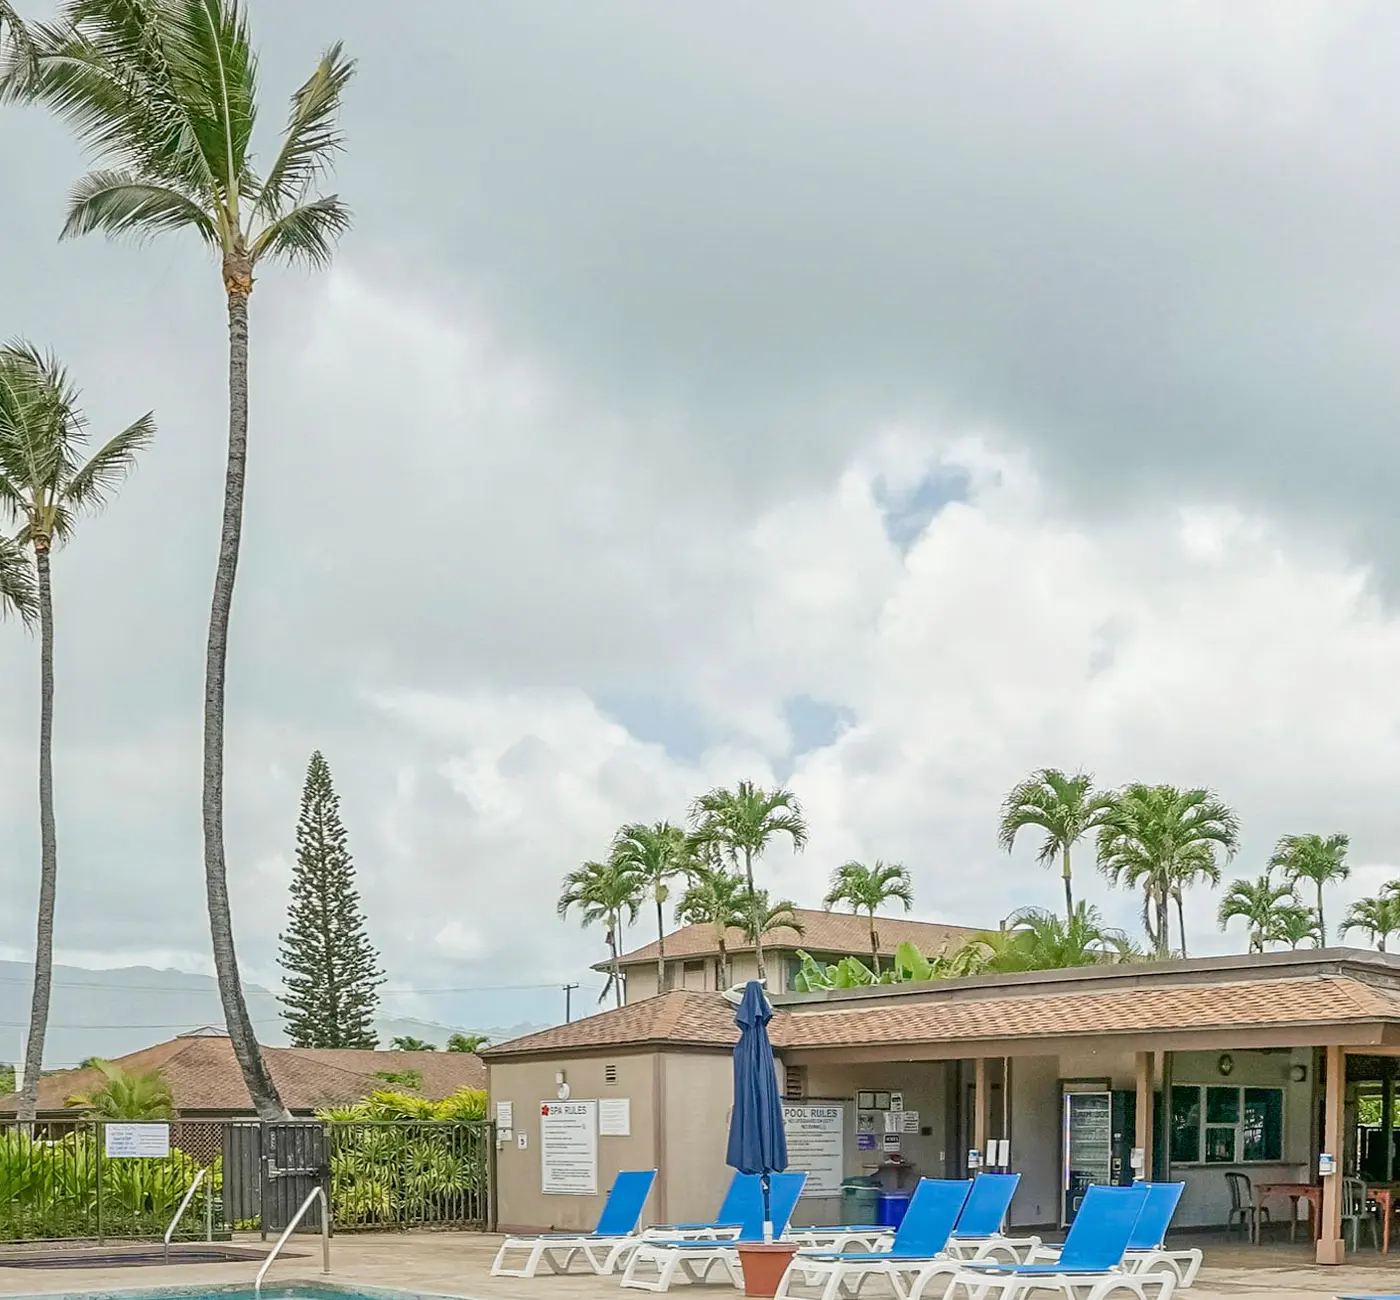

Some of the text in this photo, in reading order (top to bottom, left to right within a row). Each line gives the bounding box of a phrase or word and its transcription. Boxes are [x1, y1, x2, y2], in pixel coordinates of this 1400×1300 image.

[550, 1105, 587, 1116] SPA RULES
[784, 1109, 838, 1118] POOL RULES
